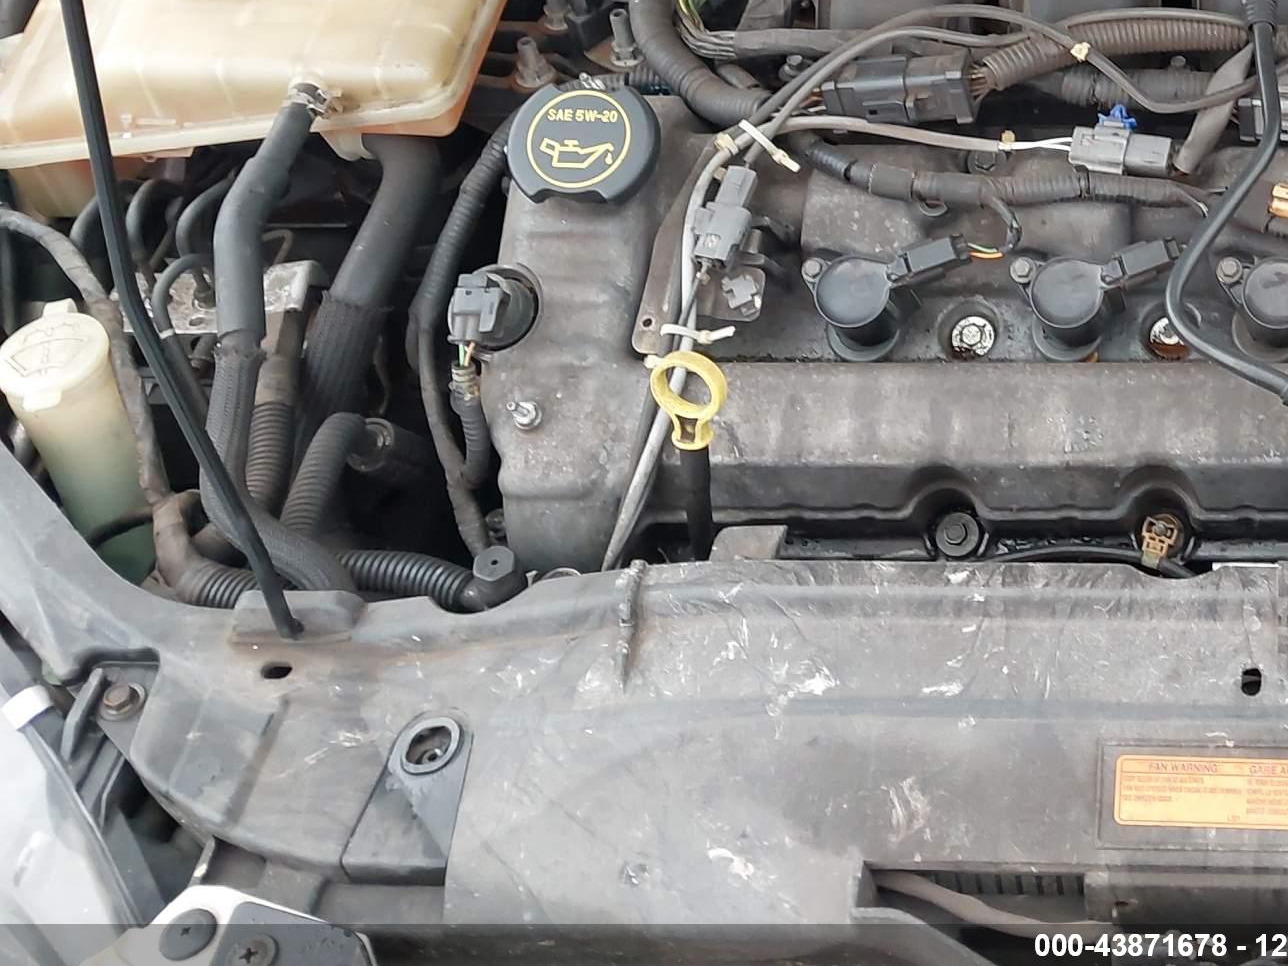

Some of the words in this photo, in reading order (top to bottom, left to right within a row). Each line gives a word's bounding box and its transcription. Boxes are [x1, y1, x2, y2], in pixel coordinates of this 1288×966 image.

[547, 108, 574, 122] SAE
[575, 108, 619, 123] 5W-20
[1148, 761, 1168, 772] FAN
[1170, 762, 1218, 773] WARNING
[1248, 764, 1279, 776] GARE
